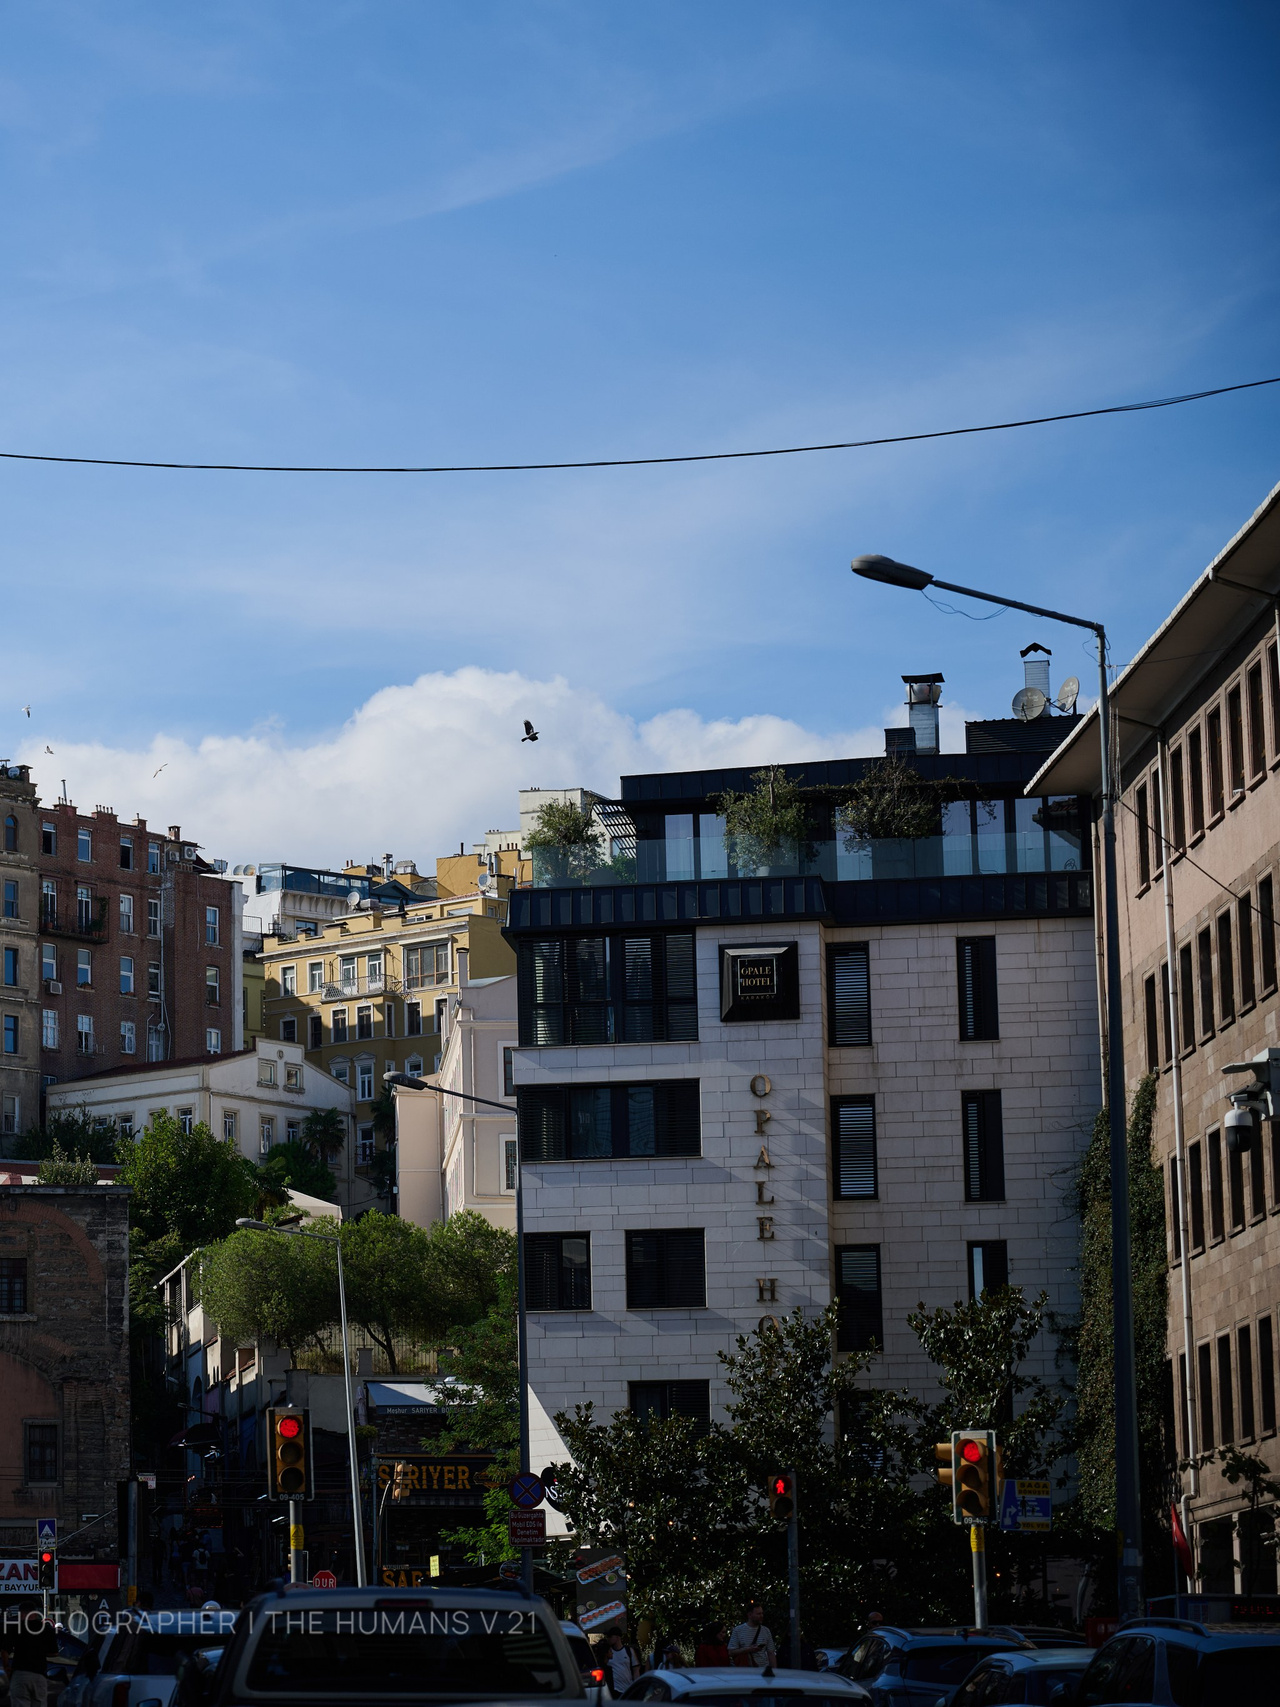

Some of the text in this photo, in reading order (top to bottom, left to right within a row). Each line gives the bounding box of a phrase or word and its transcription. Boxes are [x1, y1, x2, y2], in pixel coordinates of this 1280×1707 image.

[741, 967, 772, 976] OPALE
[741, 978, 773, 987] HOTEL
[750, 1073, 775, 1240] OPALE
[377, 1464, 471, 1490] SRIYER
[314, 1578, 336, 1588] DUR
